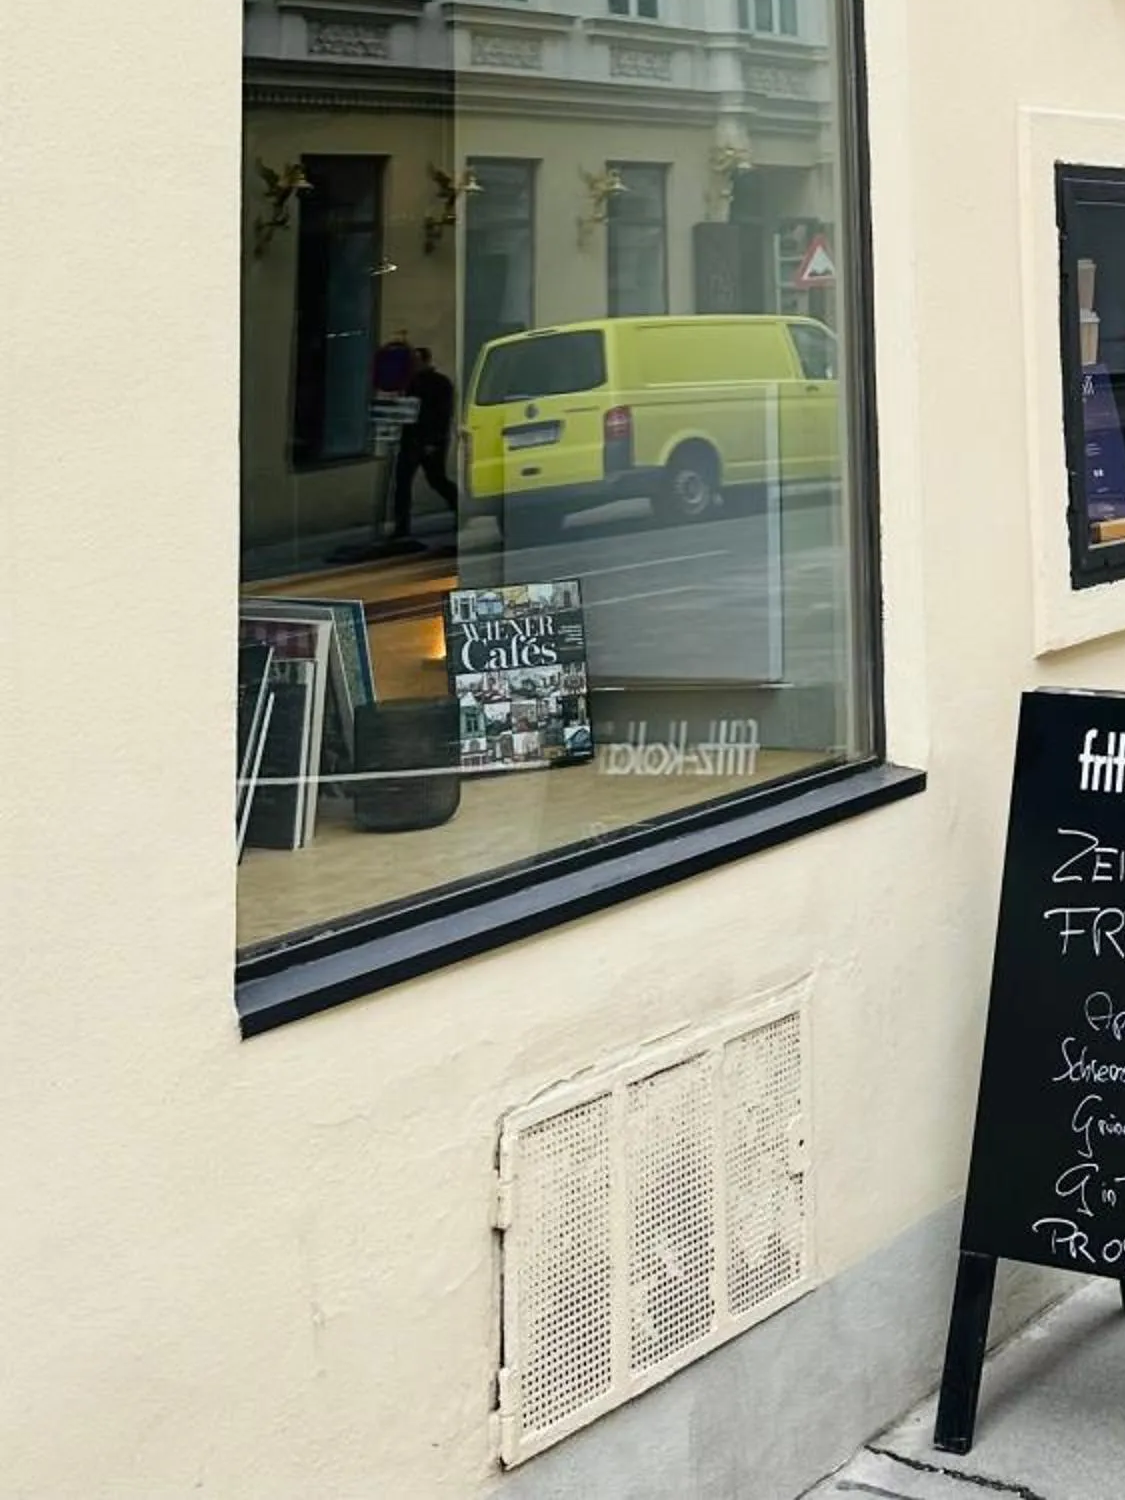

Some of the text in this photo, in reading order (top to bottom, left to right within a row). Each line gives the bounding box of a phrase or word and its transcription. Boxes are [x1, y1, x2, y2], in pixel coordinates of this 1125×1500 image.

[461, 615, 555, 642] WIENER
[461, 634, 558, 671] Cafés
[1055, 1163, 1117, 1218] Gin
